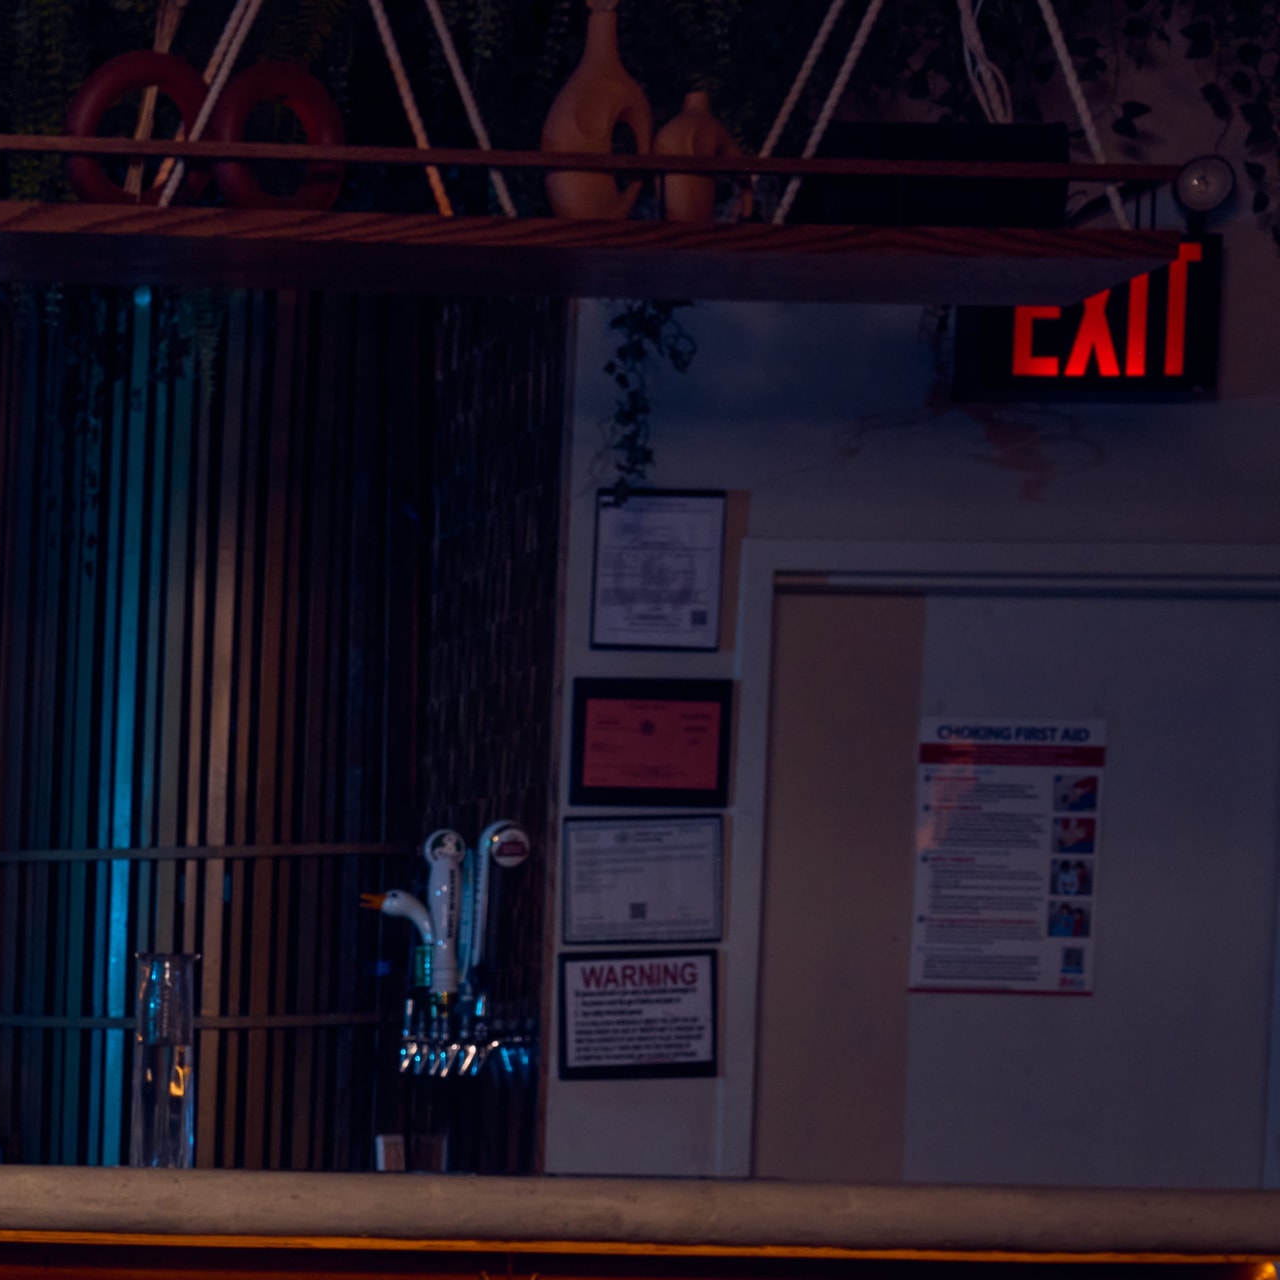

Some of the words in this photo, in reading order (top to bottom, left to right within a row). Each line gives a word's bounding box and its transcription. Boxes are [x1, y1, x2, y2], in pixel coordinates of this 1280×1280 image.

[1012, 243, 1202, 376] EXIT
[937, 725, 1012, 741] CHOKING
[1014, 726, 1060, 741] FIRST
[1060, 727, 1090, 743] AID
[580, 962, 698, 988] WARNING
